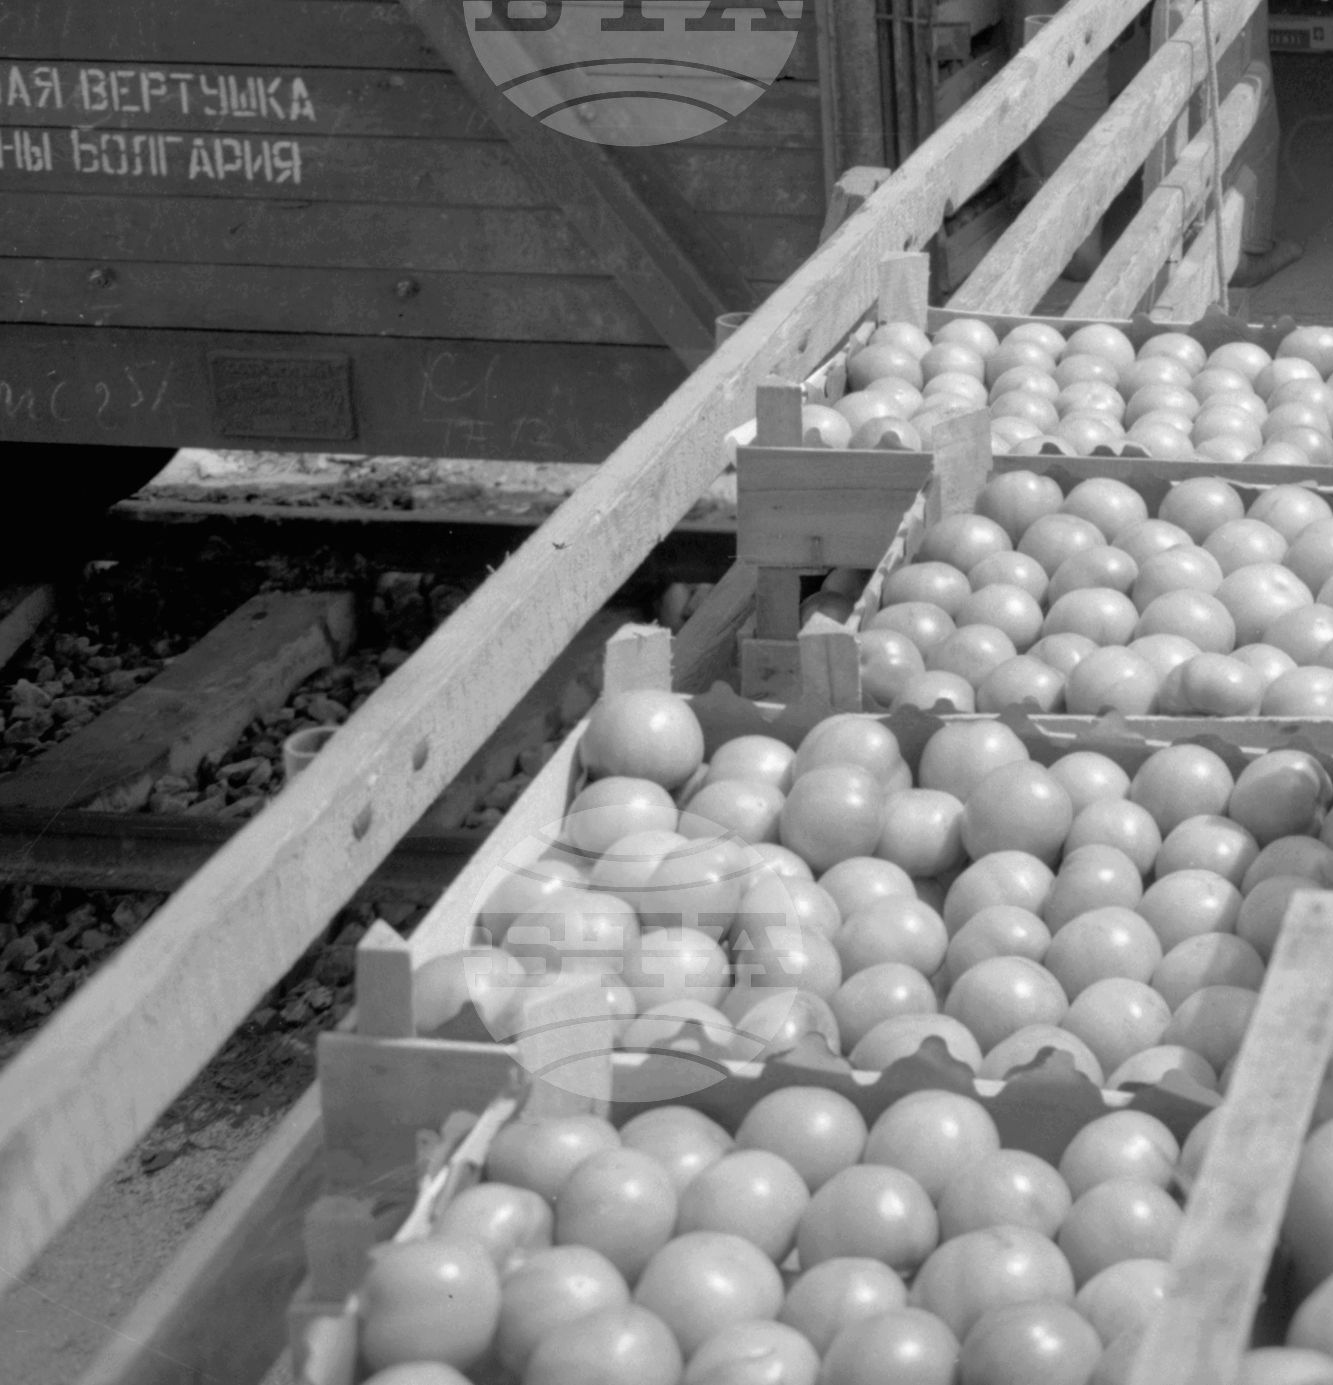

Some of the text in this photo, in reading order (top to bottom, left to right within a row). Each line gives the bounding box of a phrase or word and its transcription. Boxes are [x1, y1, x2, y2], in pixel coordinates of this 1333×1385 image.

[0, 65, 317, 122] АЯ ВЕРТУШКА
[70, 128, 302, 184] БОЛГАРИЯ
